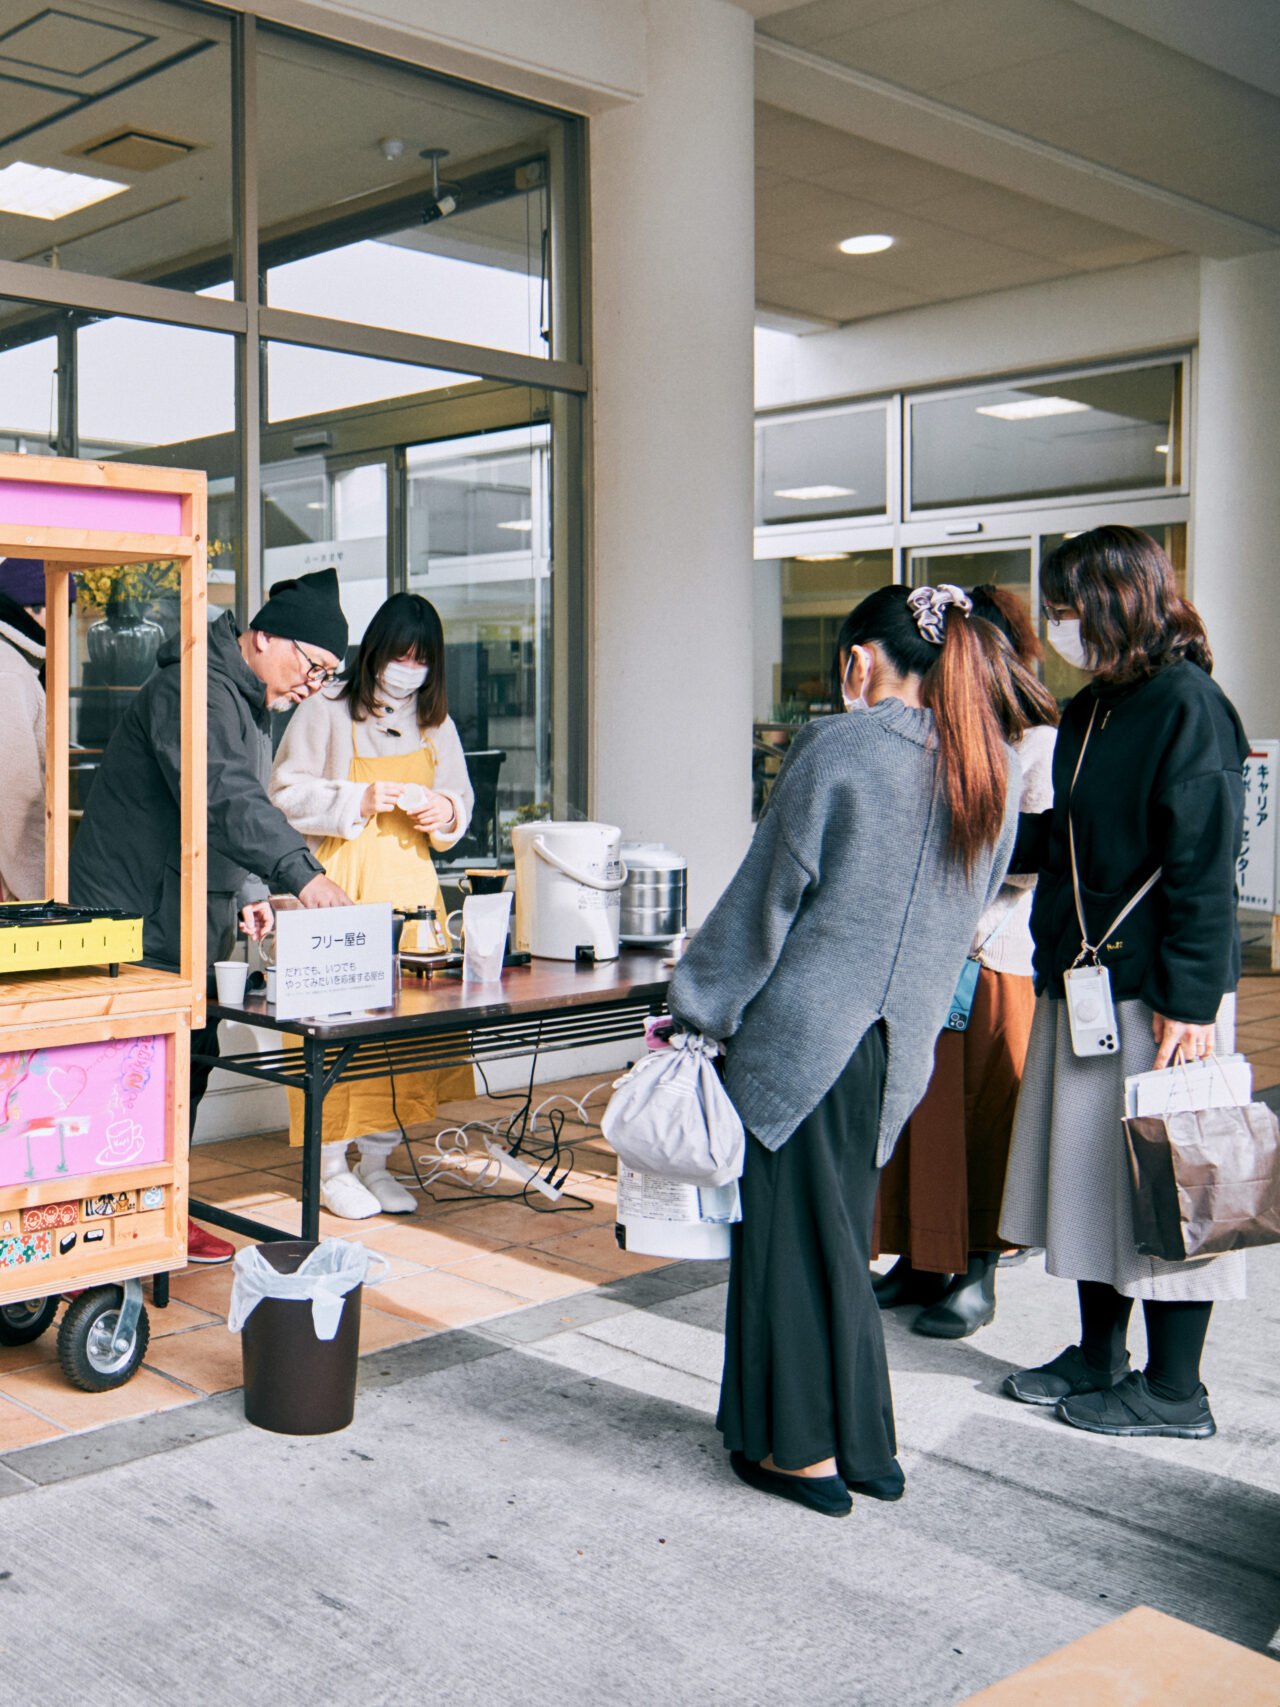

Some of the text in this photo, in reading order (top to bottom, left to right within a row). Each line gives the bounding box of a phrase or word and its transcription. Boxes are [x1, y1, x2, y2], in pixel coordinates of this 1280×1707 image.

[1257, 763, 1269, 827] キャリア
[311, 931, 366, 950] フリー屋台
[285, 962, 356, 978] だれでも、いつでも
